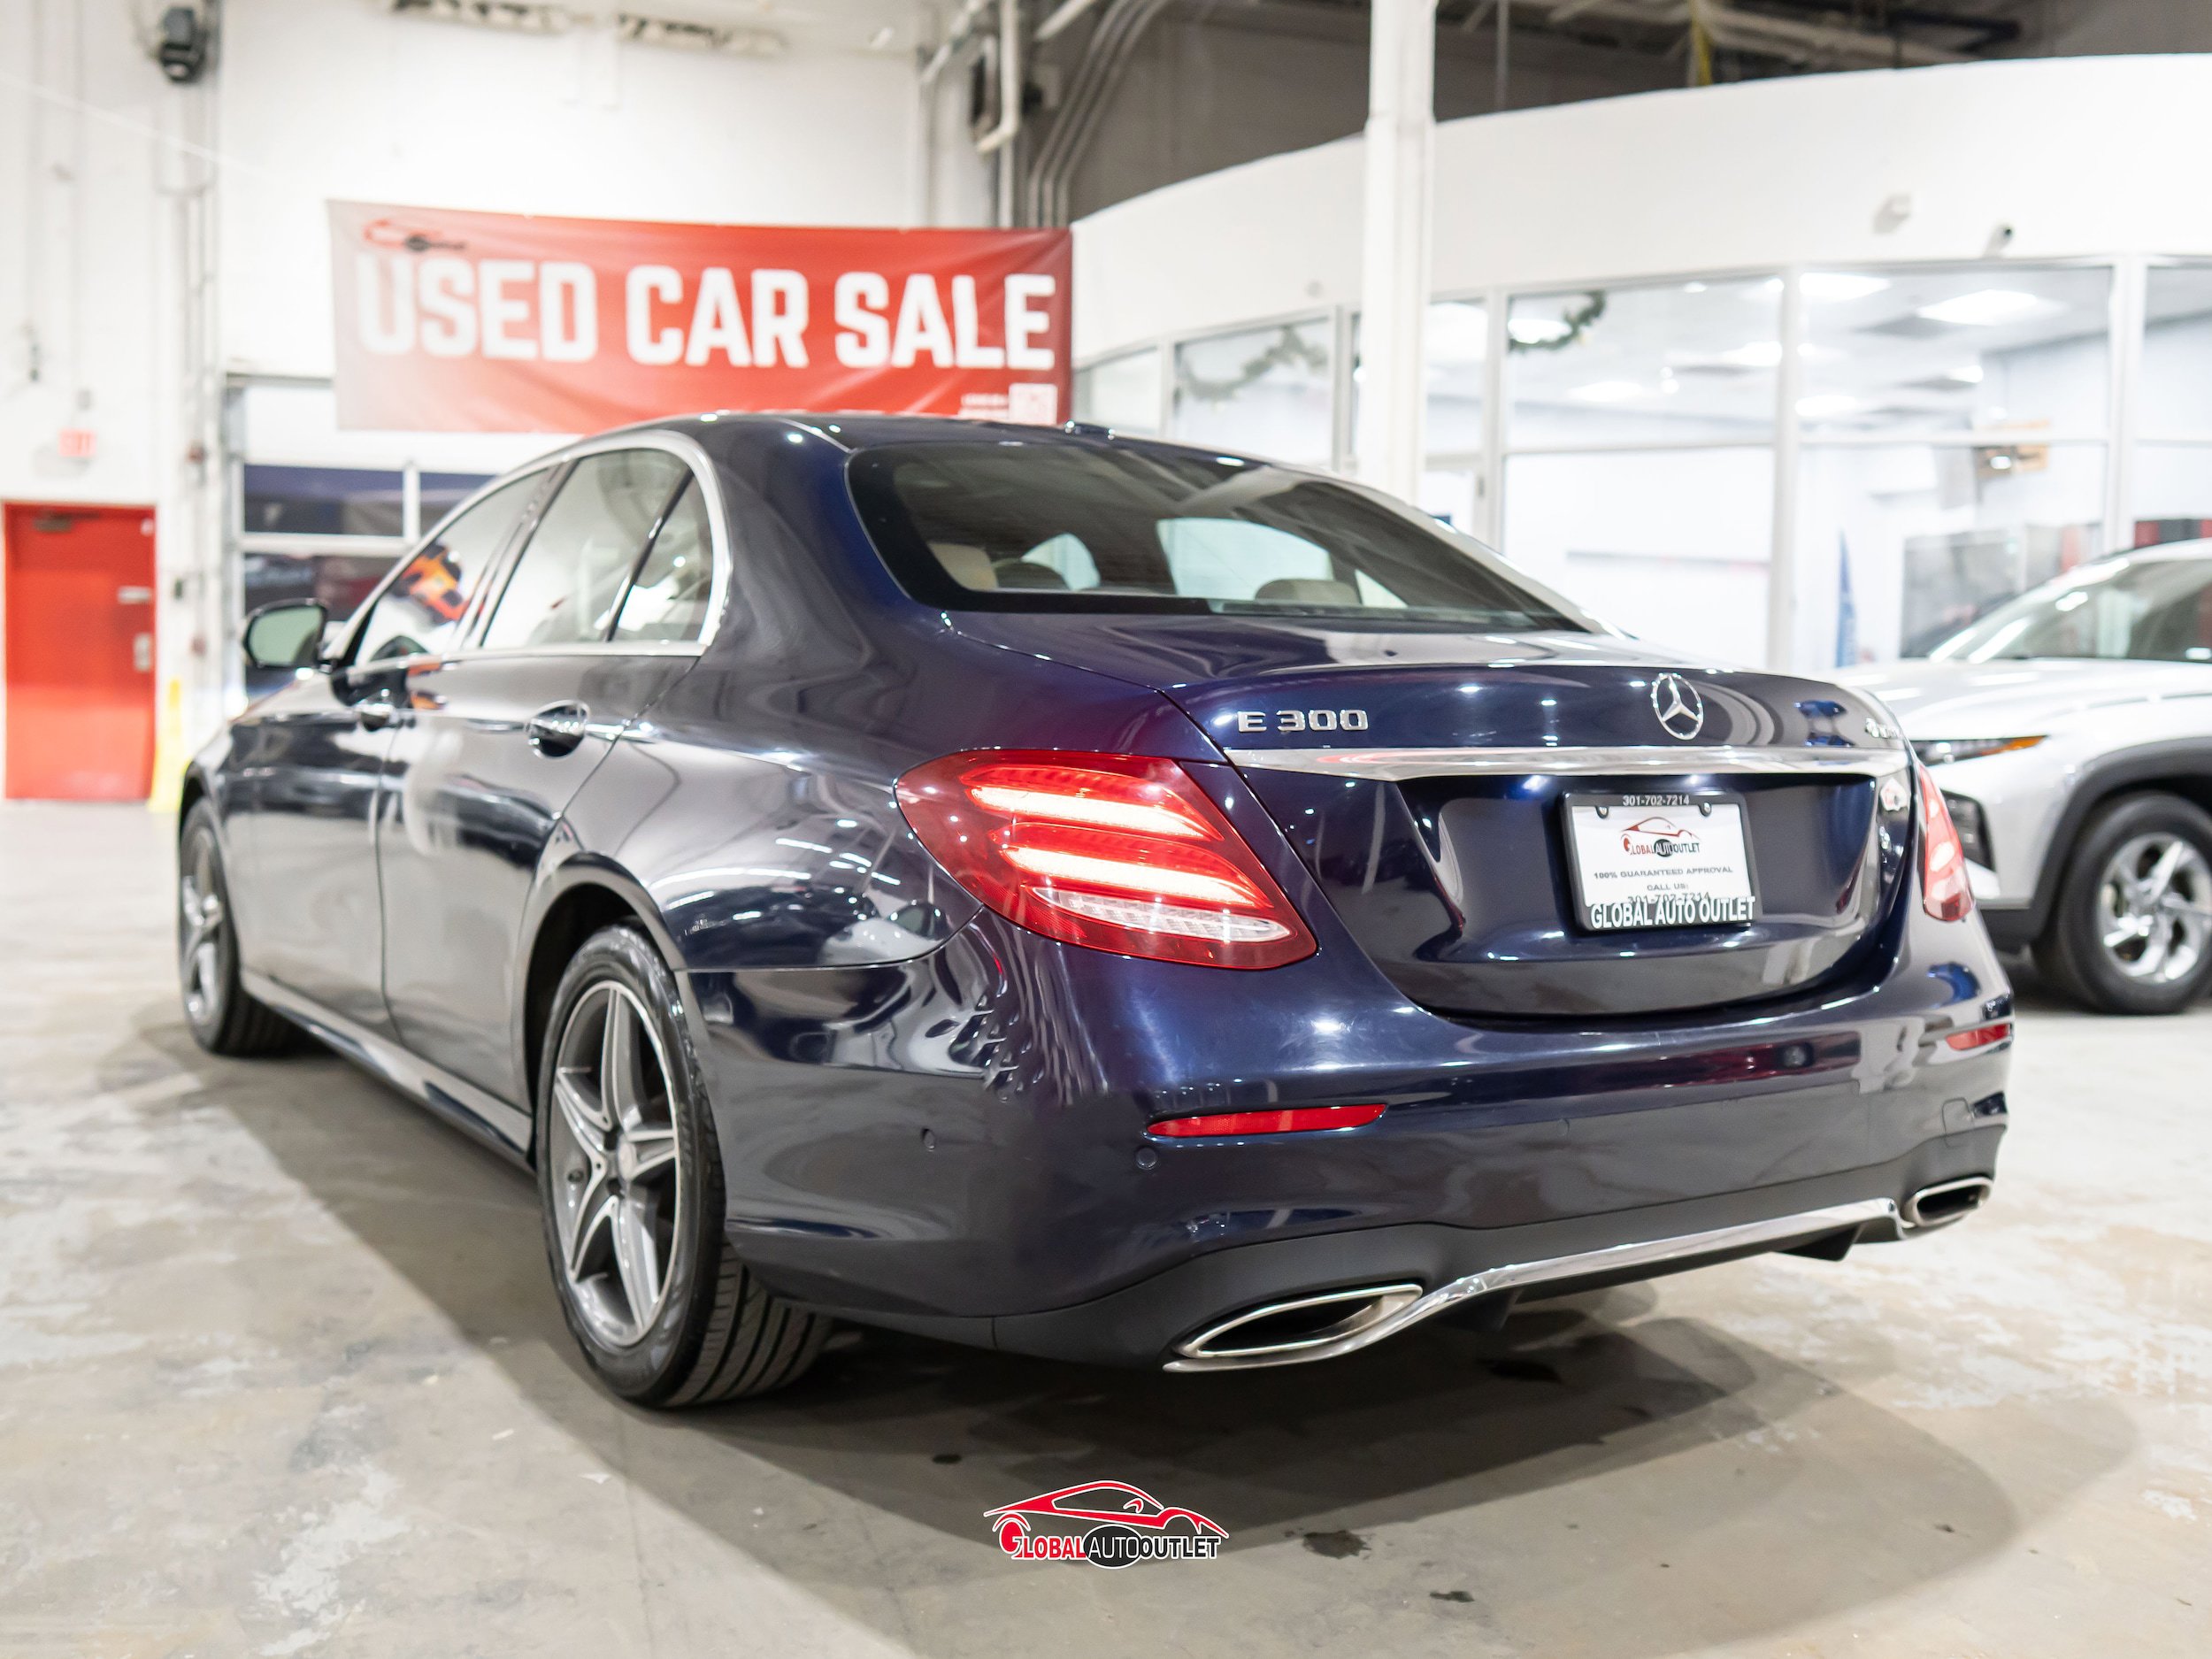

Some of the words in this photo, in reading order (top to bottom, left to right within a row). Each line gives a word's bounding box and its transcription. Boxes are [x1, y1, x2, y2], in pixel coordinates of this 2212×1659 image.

[356, 254, 598, 362] USED
[626, 265, 810, 368] CAR
[833, 272, 1056, 368] SALE
[1238, 710, 1267, 732] E
[1276, 710, 1369, 731] 300
[1622, 795, 1690, 806] 301-702-7214
[1620, 868, 1683, 879] GUARANTEED
[1686, 865, 1733, 875] APPROVAL
[1591, 902, 1653, 929] GLOBAL
[1655, 898, 1696, 925] AUTO
[1699, 895, 1755, 923] OUTLET
